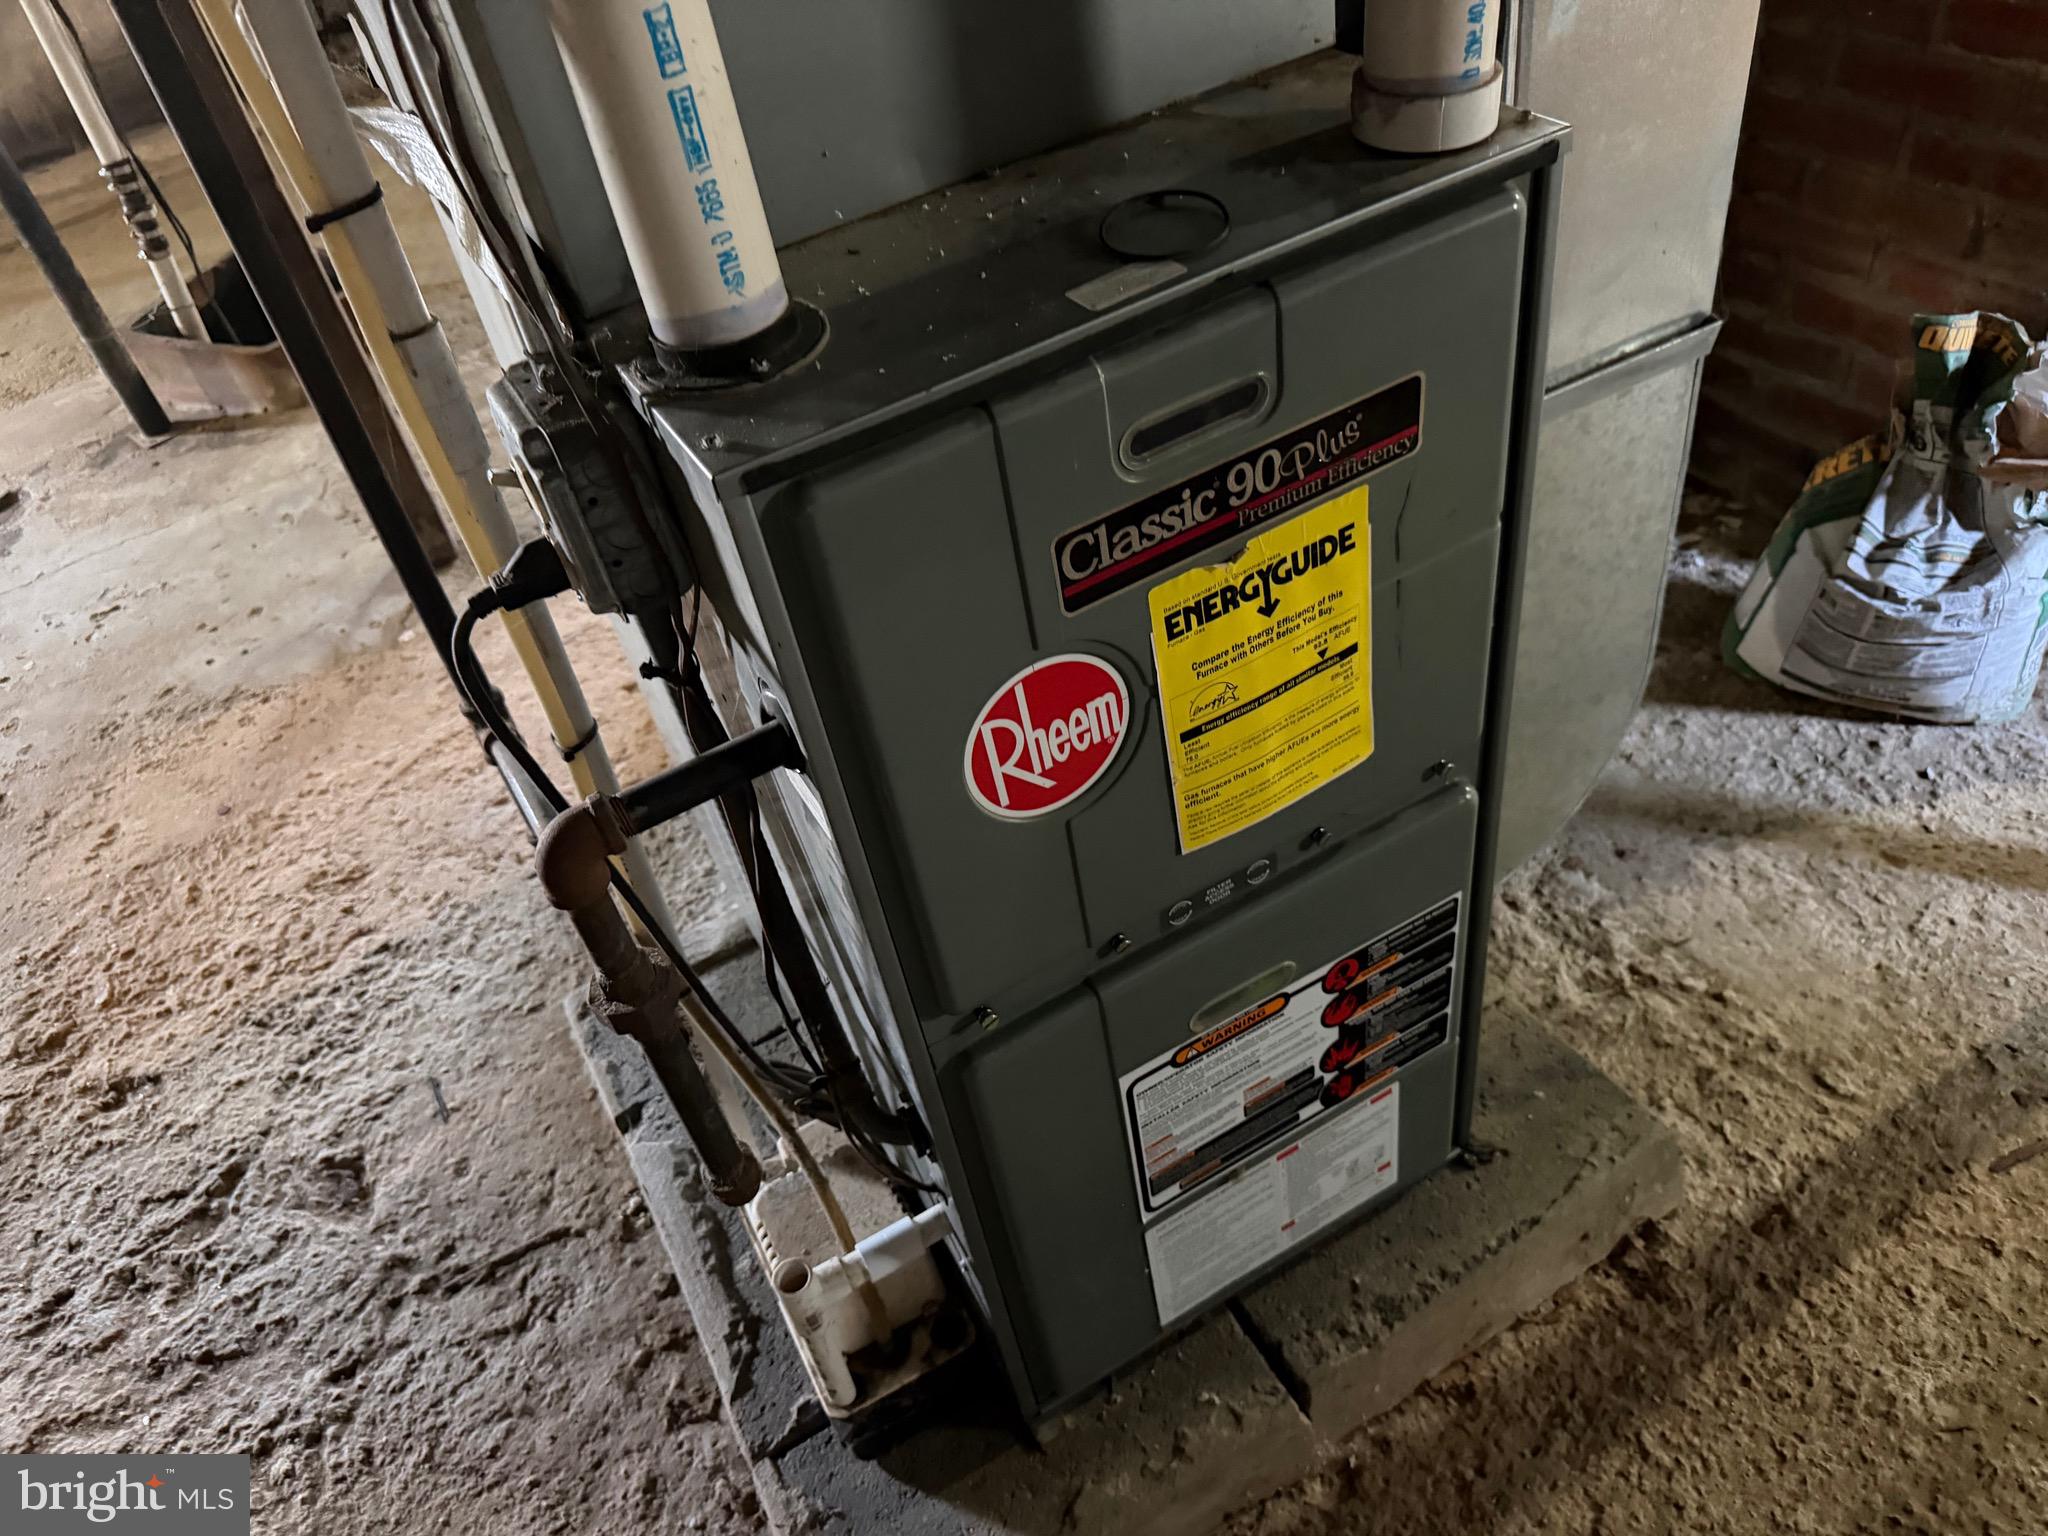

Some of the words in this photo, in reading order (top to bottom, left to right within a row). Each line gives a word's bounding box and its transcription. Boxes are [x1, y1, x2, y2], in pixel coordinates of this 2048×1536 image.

[1238, 476, 1322, 528] Premium
[1328, 432, 1414, 485] Efficiency
[1061, 488, 1215, 580] Classic
[1164, 523, 1356, 641] ENERGYGUIDE
[1192, 584, 1216, 599] standard
[1231, 559, 1264, 580] Government
[1192, 650, 1228, 671] Compare
[1232, 642, 1244, 652] the
[1248, 626, 1274, 645] Energy
[1277, 604, 1314, 629] Efficiency
[1318, 596, 1325, 607] of
[1328, 591, 1342, 602] this
[1197, 661, 1228, 680] Furnace
[1231, 651, 1247, 663] with
[1250, 637, 1273, 653] Others
[1276, 624, 1300, 639] Before
[1303, 612, 1316, 625] You
[1319, 606, 1334, 617] Buy.
[1329, 617, 1356, 634] Efficiency
[1202, 714, 1224, 731] Energy
[1226, 697, 1258, 720] efficiency
[1259, 691, 1277, 703] range
[1279, 685, 1284, 693] of
[1295, 668, 1316, 683] similar
[981, 681, 1120, 807] Rheem
[1184, 736, 1200, 749] Least
[1184, 793, 1198, 801] Gas
[1201, 778, 1231, 796] furnaces
[1234, 770, 1246, 780] that
[1248, 762, 1264, 773] have
[1266, 749, 1284, 764] higher
[1311, 729, 1320, 737] are
[1322, 719, 1336, 730] more
[1340, 706, 1359, 720] energy
[1185, 786, 1219, 808] efficient.
[1201, 1008, 1265, 1048] WARNING
